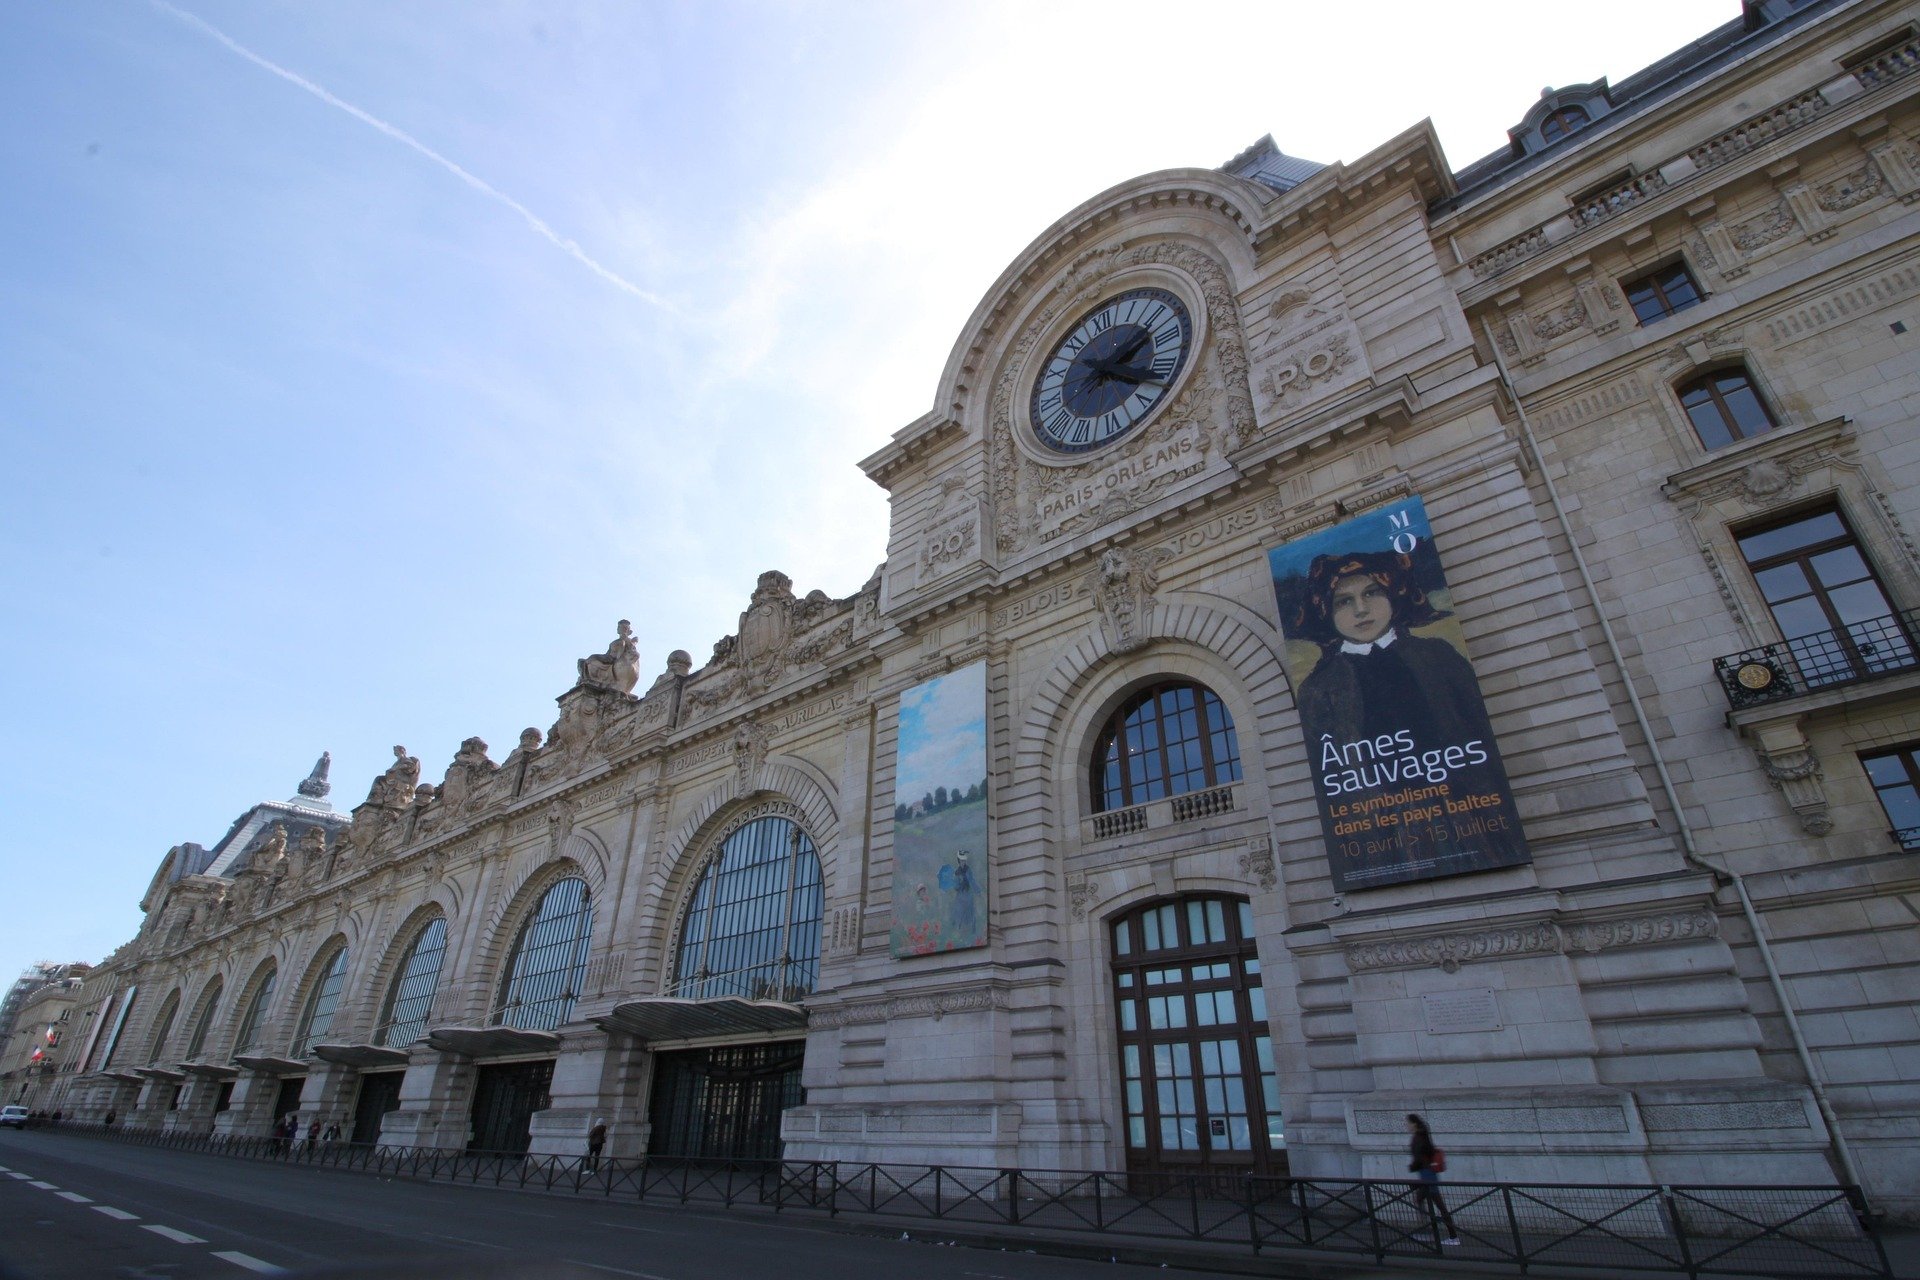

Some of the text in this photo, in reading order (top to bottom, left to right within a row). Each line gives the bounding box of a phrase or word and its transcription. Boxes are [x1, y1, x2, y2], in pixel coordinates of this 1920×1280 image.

[1091, 309, 1111, 336] XII
[1154, 324, 1180, 348] III
[1065, 335, 1085, 356] XI
[1070, 419, 1091, 443] VII
[1104, 411, 1121, 436] VI
[1171, 507, 1258, 554] TOURS
[1387, 510, 1410, 531] M
[1010, 583, 1073, 622] BLOIS
[780, 694, 844, 731] AURILLAC
[676, 742, 726, 771] QUIMPER
[1320, 729, 1415, 771] Âmes
[1323, 740, 1488, 796] sauvages
[1329, 784, 1450, 818] Le symbolisme
[1334, 793, 1502, 836] dans les pays baltes
[1339, 840, 1361, 858] 10
[1366, 831, 1403, 855] avril
[1426, 824, 1448, 843] 15
[1453, 814, 1510, 843] juillet
